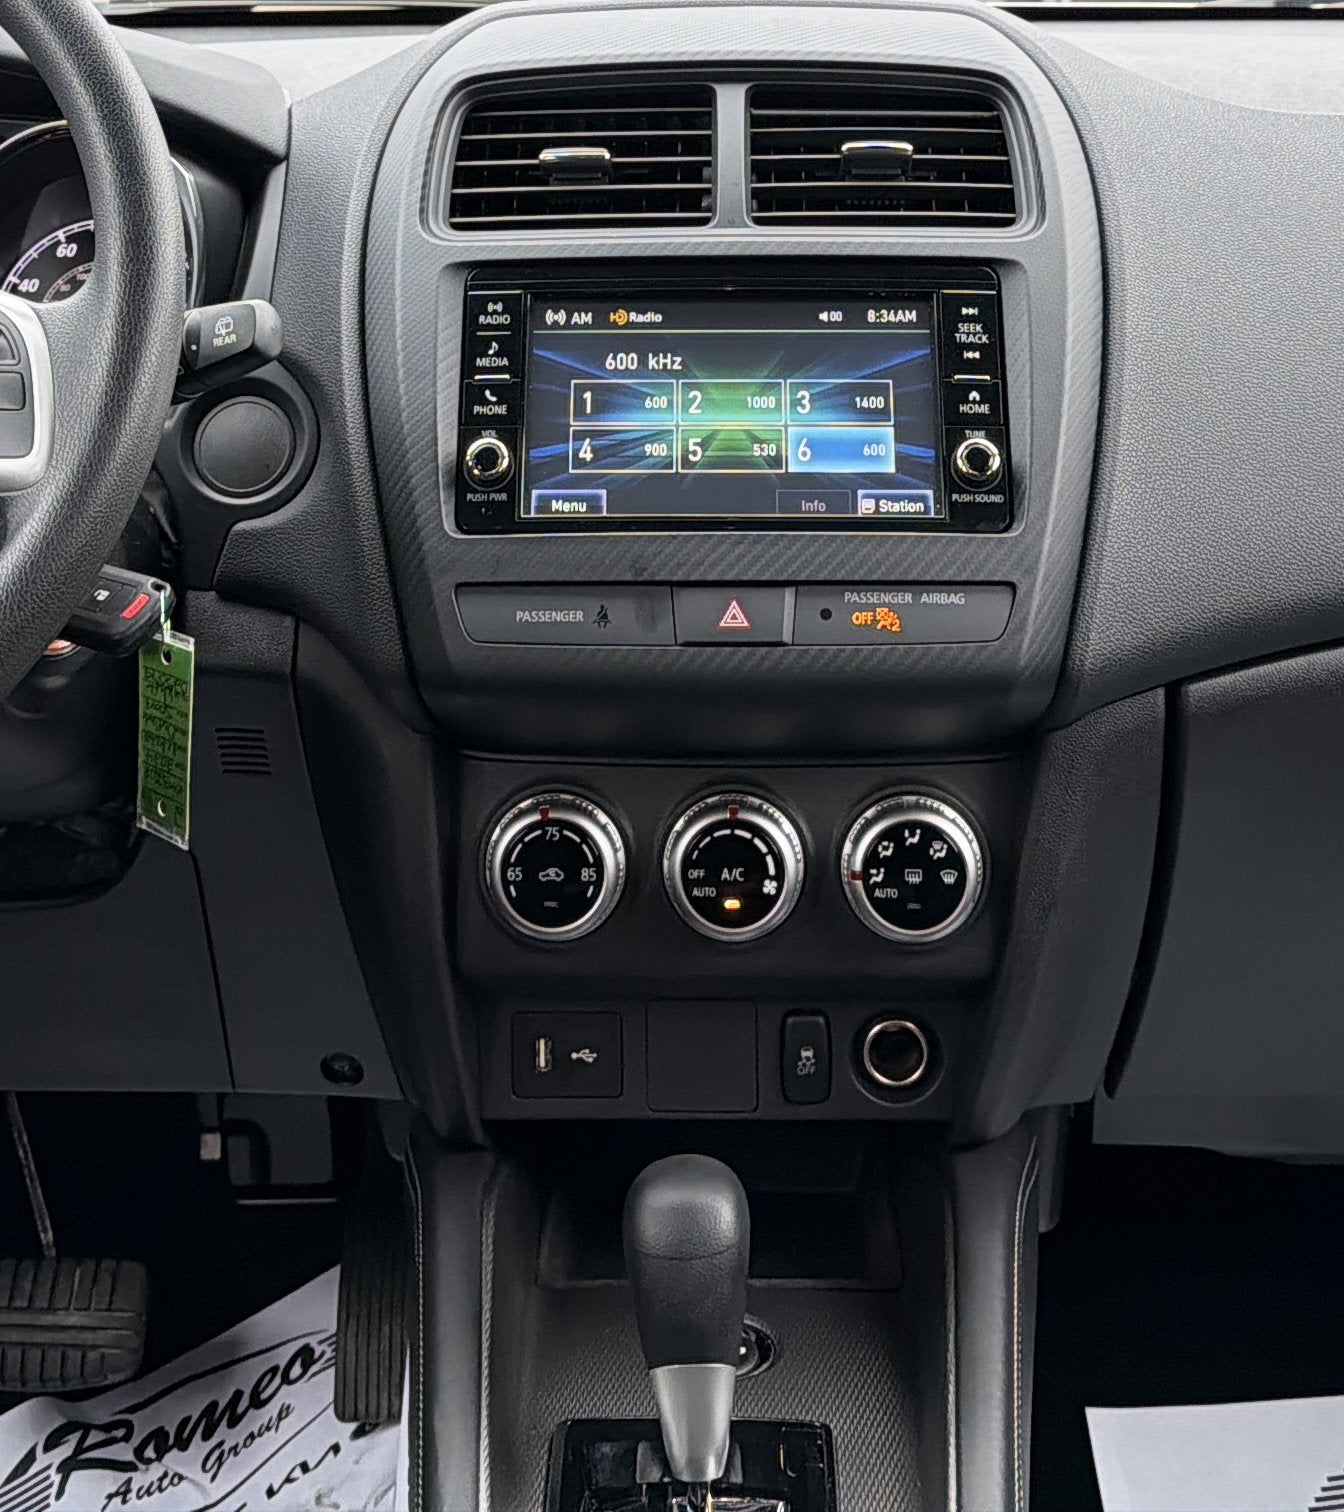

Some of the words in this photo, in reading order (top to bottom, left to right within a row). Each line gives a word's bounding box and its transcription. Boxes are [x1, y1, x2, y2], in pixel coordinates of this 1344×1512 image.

[56, 243, 78, 258] 60
[17, 278, 40, 293] 40
[478, 314, 511, 325] RADIO
[570, 311, 593, 326] AM
[629, 310, 663, 324] Radio
[829, 310, 843, 323] 00
[866, 309, 918, 325] 8:34AM
[957, 323, 984, 334] SEEK
[212, 333, 237, 348] REAR
[954, 333, 989, 344] TRACK
[475, 356, 509, 368] MEDIA
[605, 352, 639, 371] 600
[647, 352, 683, 371] kHz
[582, 390, 593, 415] 1
[644, 396, 669, 410] 600
[688, 390, 703, 415] 2
[746, 395, 777, 410] 1000
[795, 390, 811, 415] 3
[855, 395, 886, 410] 1400
[959, 403, 991, 415] HOME
[473, 405, 508, 416] PHONE
[481, 430, 498, 438] VOL
[964, 430, 986, 438] TUNE
[578, 438, 594, 462] 4
[643, 443, 668, 457] 900
[687, 438, 703, 462] 5
[752, 443, 777, 457] 530
[797, 437, 812, 462] 6
[862, 443, 886, 457] 600
[466, 493, 488, 502] PUSH
[488, 493, 508, 502] PWR
[951, 493, 974, 503] PUSH
[974, 493, 1005, 504] SOUND
[550, 498, 588, 514] Menu
[801, 500, 827, 513] Info
[878, 499, 925, 514] Station
[843, 591, 913, 605] PASSENGER
[919, 591, 966, 605] AIRBAG
[515, 608, 584, 623] PASSENGER
[852, 611, 874, 626] OFF
[544, 826, 560, 842] 75
[506, 867, 523, 882] 65
[580, 867, 597, 882] 85
[687, 868, 706, 881] OFF
[720, 867, 745, 883] A/C
[691, 886, 717, 899] AUTO
[873, 887, 899, 900] AUTO
[42, 1341, 324, 1502] Romeo
[100, 1472, 188, 1512] Auto
[200, 1401, 296, 1484] Group
